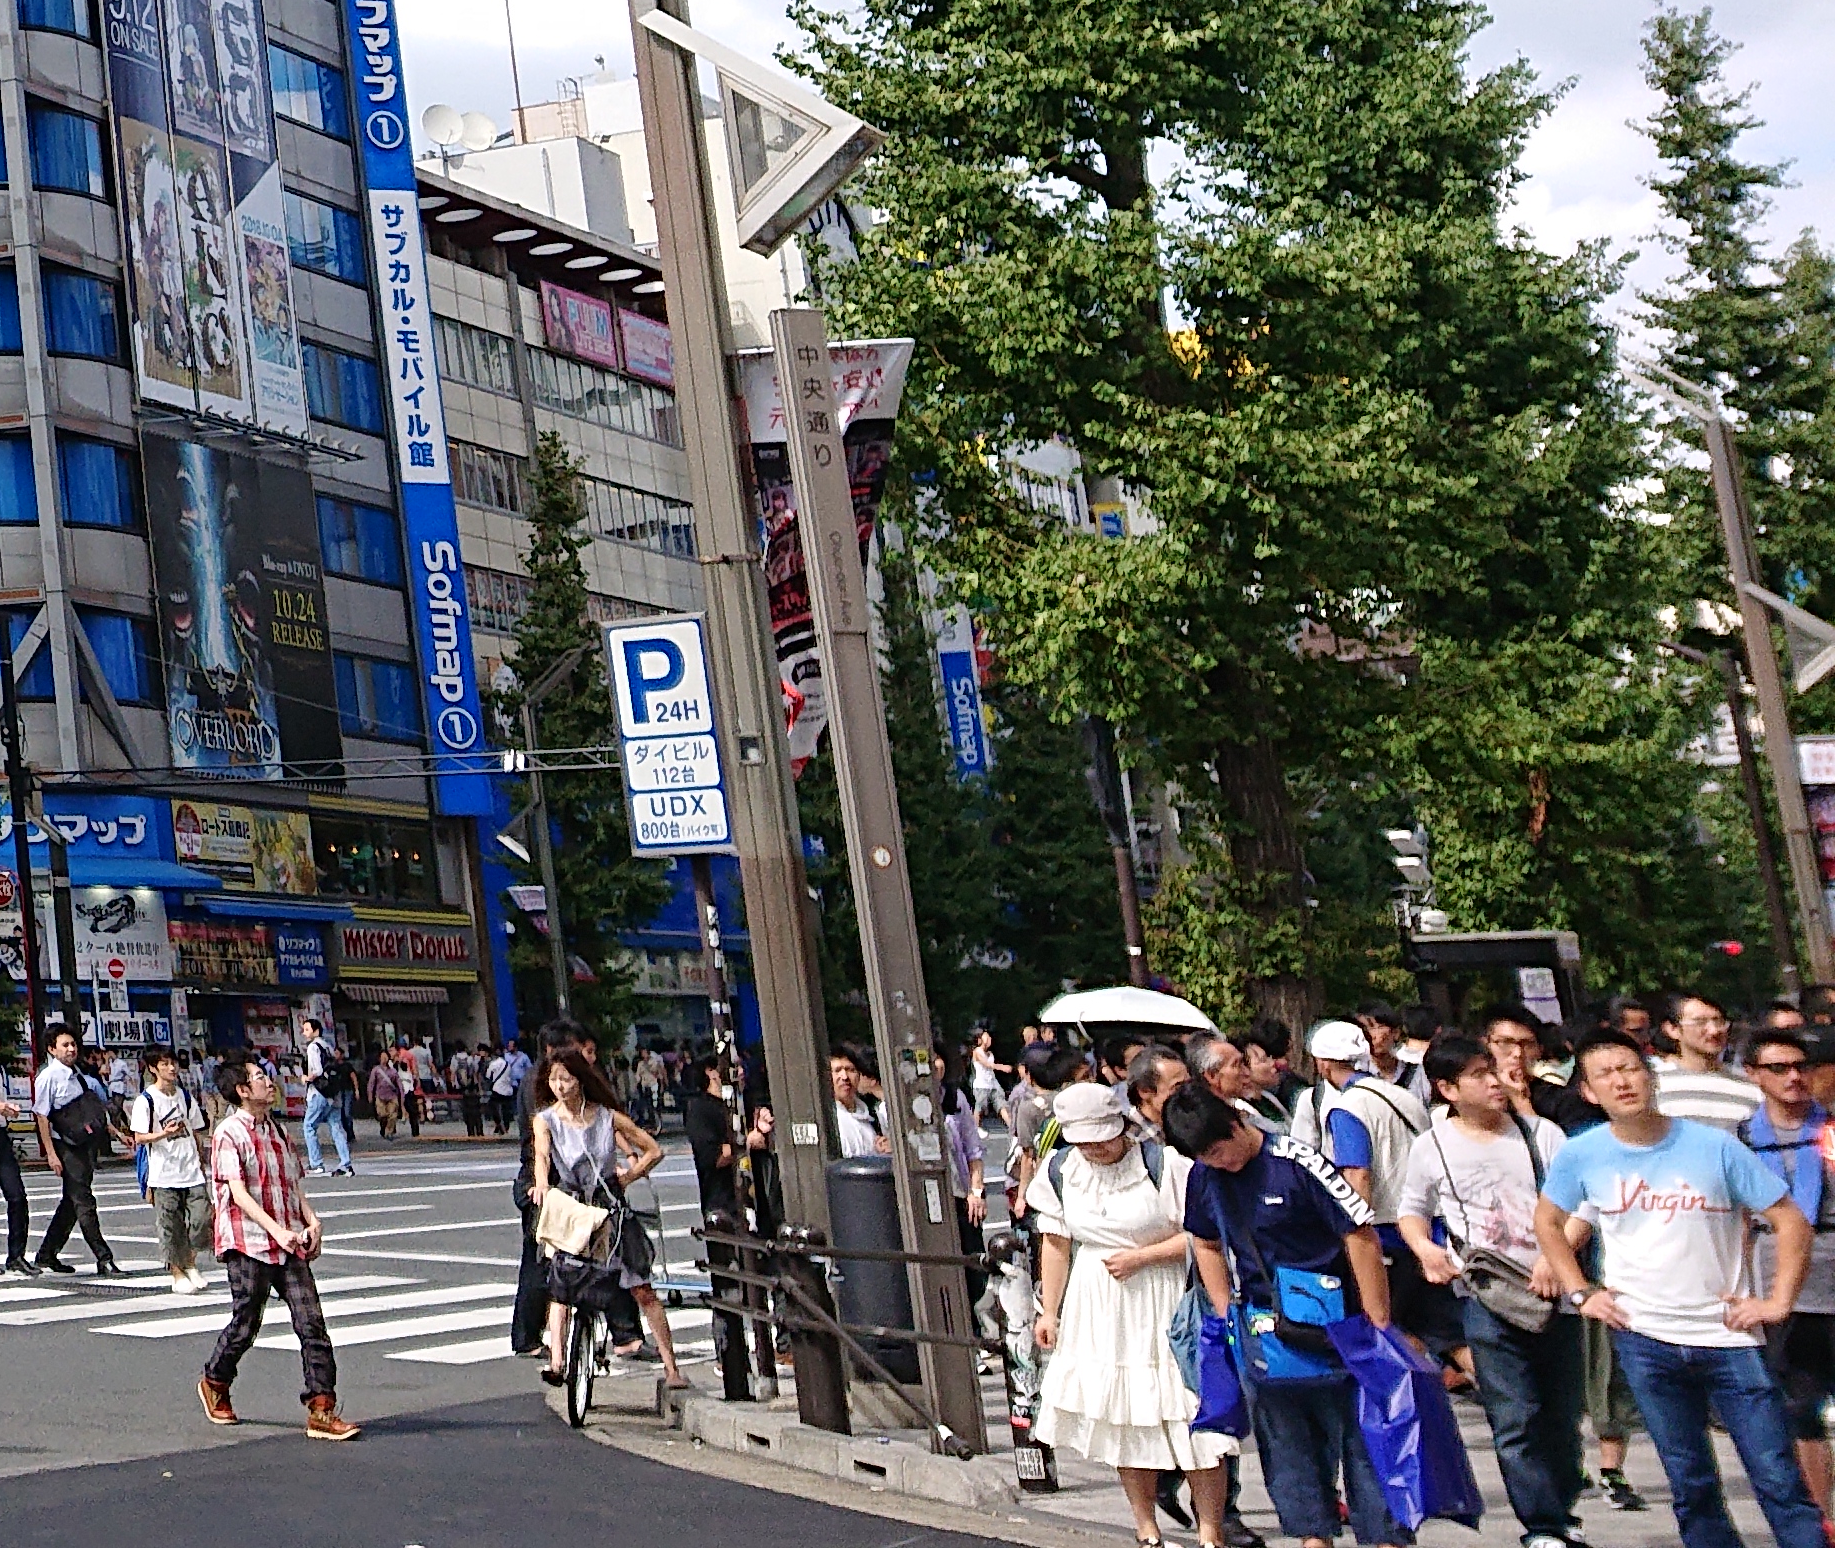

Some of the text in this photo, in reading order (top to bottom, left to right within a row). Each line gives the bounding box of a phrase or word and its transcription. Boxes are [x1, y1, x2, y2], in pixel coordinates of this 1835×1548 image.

[111, 21, 158, 60] ON SALE
[381, 203, 435, 470] サブカル・モバイル館
[797, 345, 832, 467] 中央通り
[273, 589, 316, 624] 10.24
[422, 540, 463, 703] Sofmap
[272, 621, 324, 651] RELEASE
[622, 638, 686, 725] P
[176, 710, 276, 761] OVERLORD
[656, 699, 700, 723] 24H
[952, 676, 979, 766] Sofmap
[634, 740, 710, 765] ダイビル
[653, 765, 696, 786] 112台
[650, 794, 707, 818] UDX
[1272, 1135, 1376, 1227] SPALDIN
[1606, 1173, 1723, 1226] Virgin
